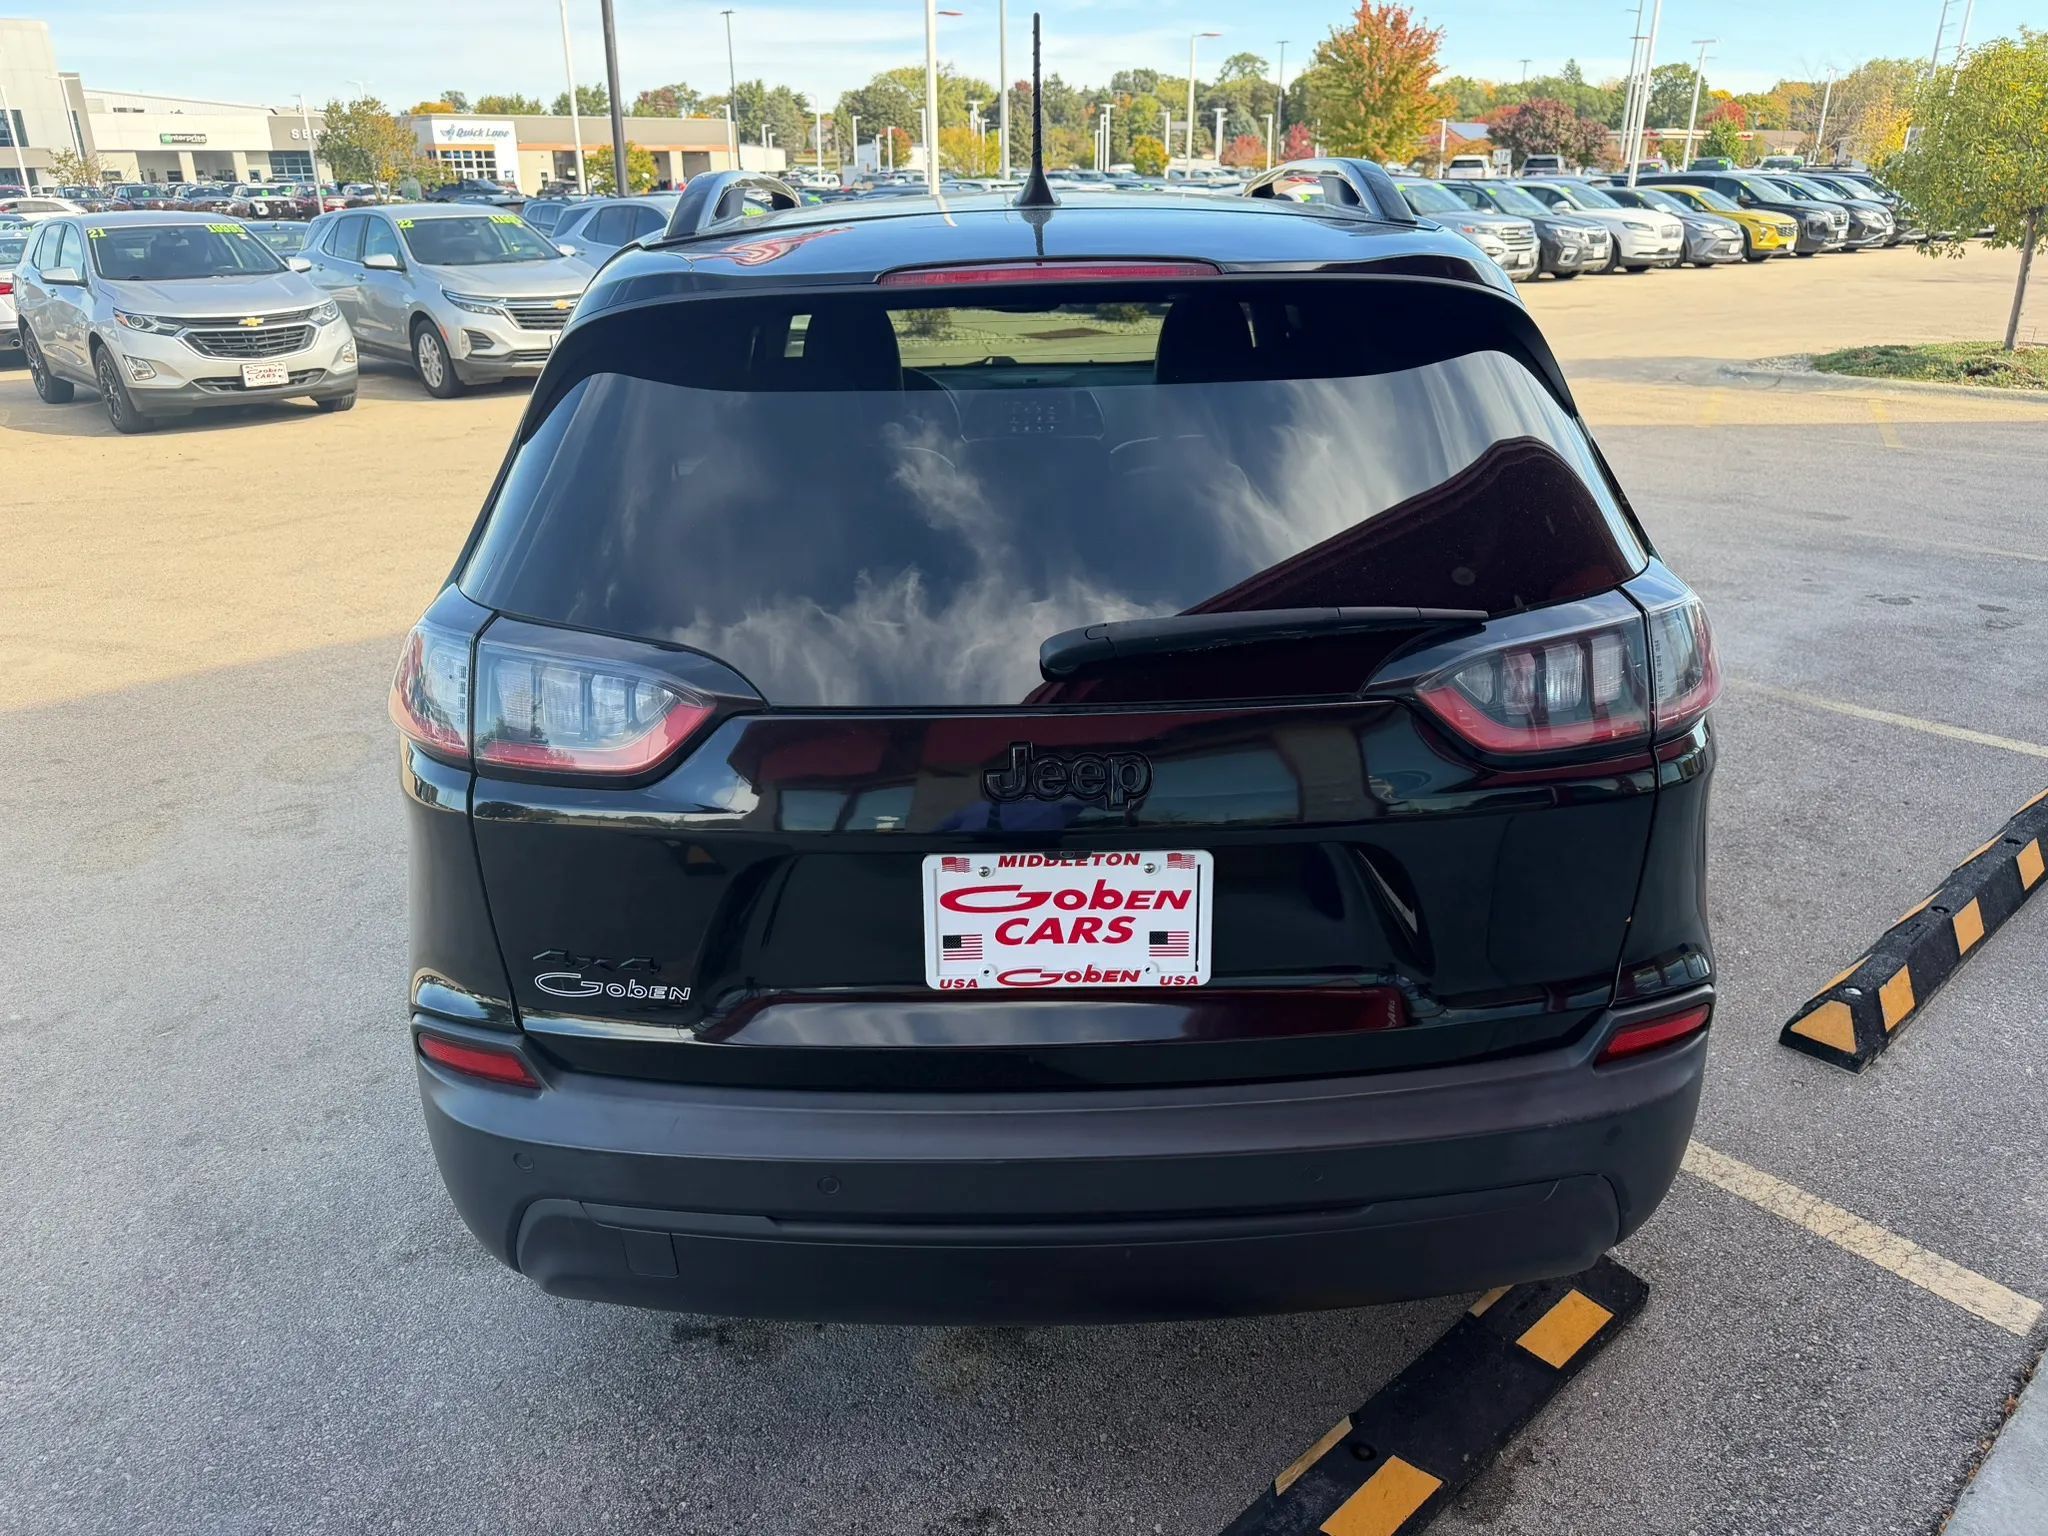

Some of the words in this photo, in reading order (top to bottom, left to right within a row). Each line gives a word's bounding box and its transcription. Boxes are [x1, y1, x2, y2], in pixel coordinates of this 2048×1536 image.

[456, 127, 485, 138] Quick
[486, 128, 510, 138] Lane
[88, 228, 107, 238] 21
[983, 742, 1153, 811] Jeep
[995, 916, 1137, 946] CARS
[939, 979, 978, 989] USA
[1159, 975, 1199, 985] USA
